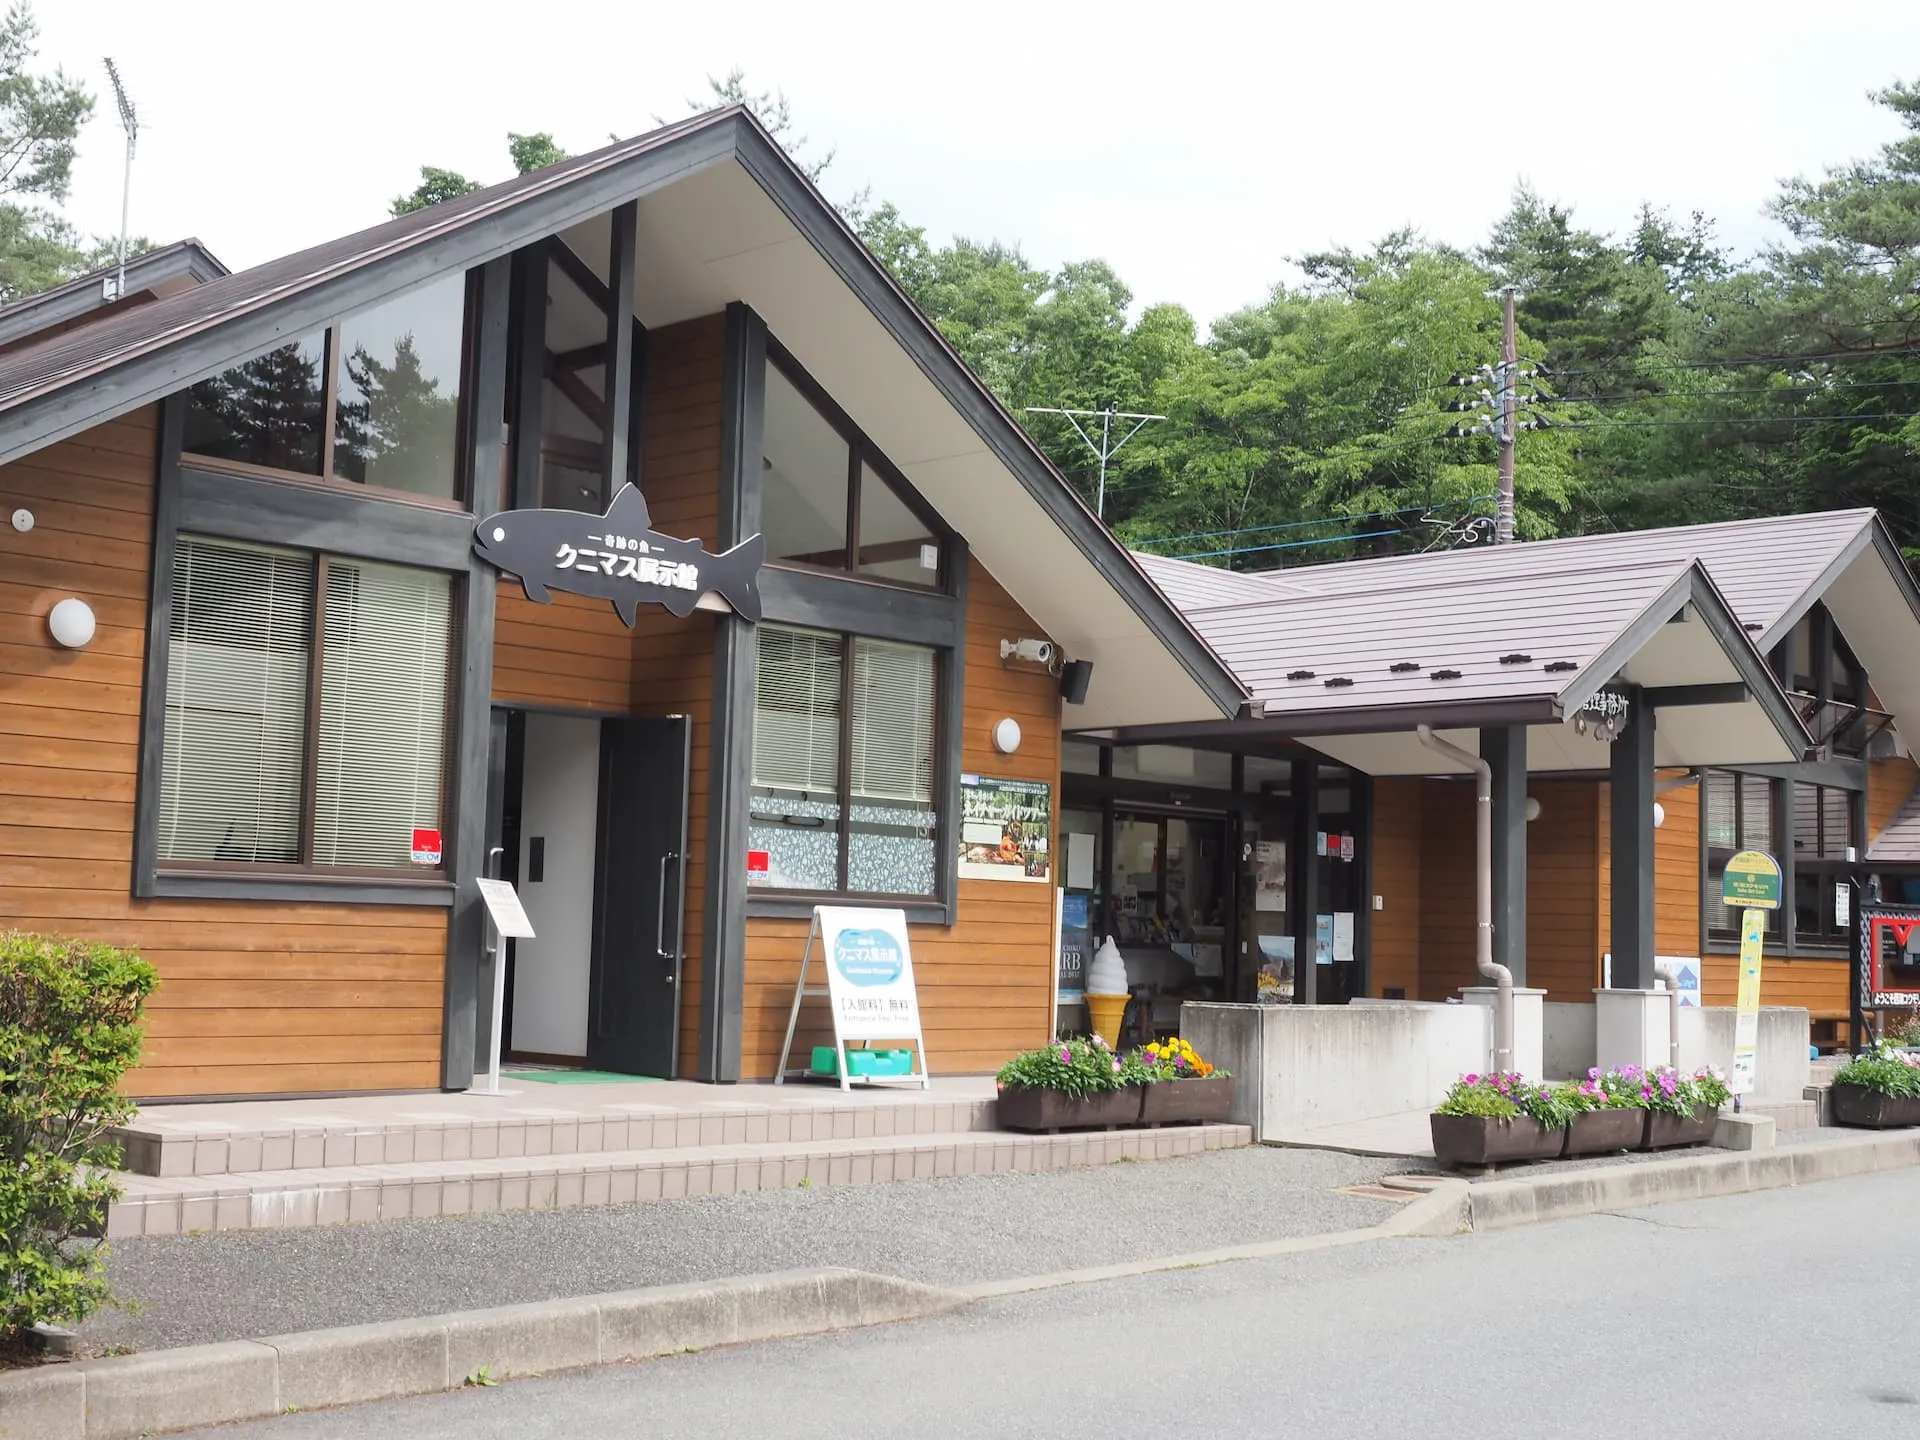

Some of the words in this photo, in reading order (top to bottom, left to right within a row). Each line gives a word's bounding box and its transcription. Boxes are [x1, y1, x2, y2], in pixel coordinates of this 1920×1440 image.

[604, 534, 649, 553] 奇跡の魚
[555, 543, 698, 590] クニマス展示館
[1061, 952, 1081, 970] RB
